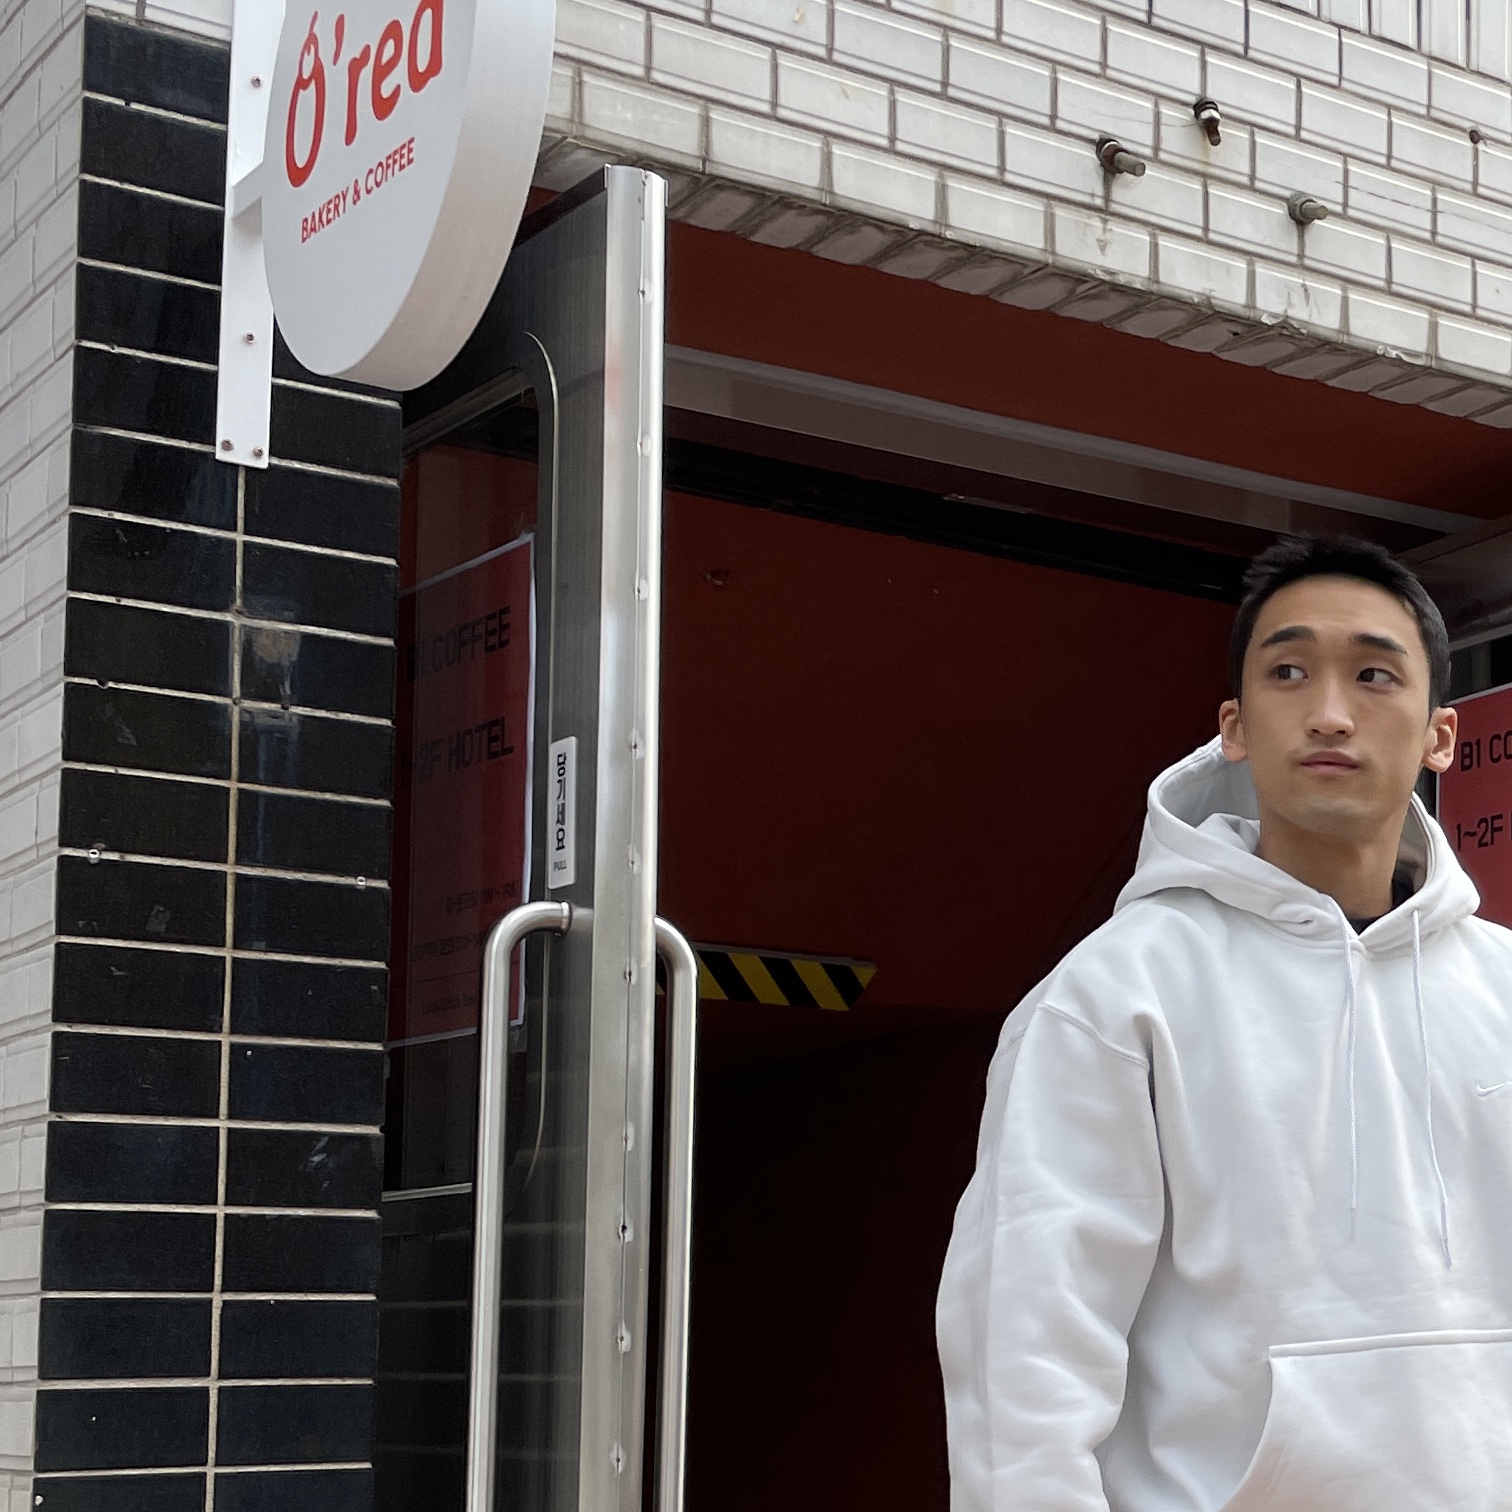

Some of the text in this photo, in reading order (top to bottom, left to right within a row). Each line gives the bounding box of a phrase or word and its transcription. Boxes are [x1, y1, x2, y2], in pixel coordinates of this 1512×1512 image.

[301, 136, 415, 244] BAKERY & COFFEE
[431, 605, 511, 673] COFFEE
[447, 715, 515, 773] HOTEL
[1461, 738, 1481, 772] B1
[1455, 813, 1503, 852] 1~2F
[553, 859, 568, 872] PULL
